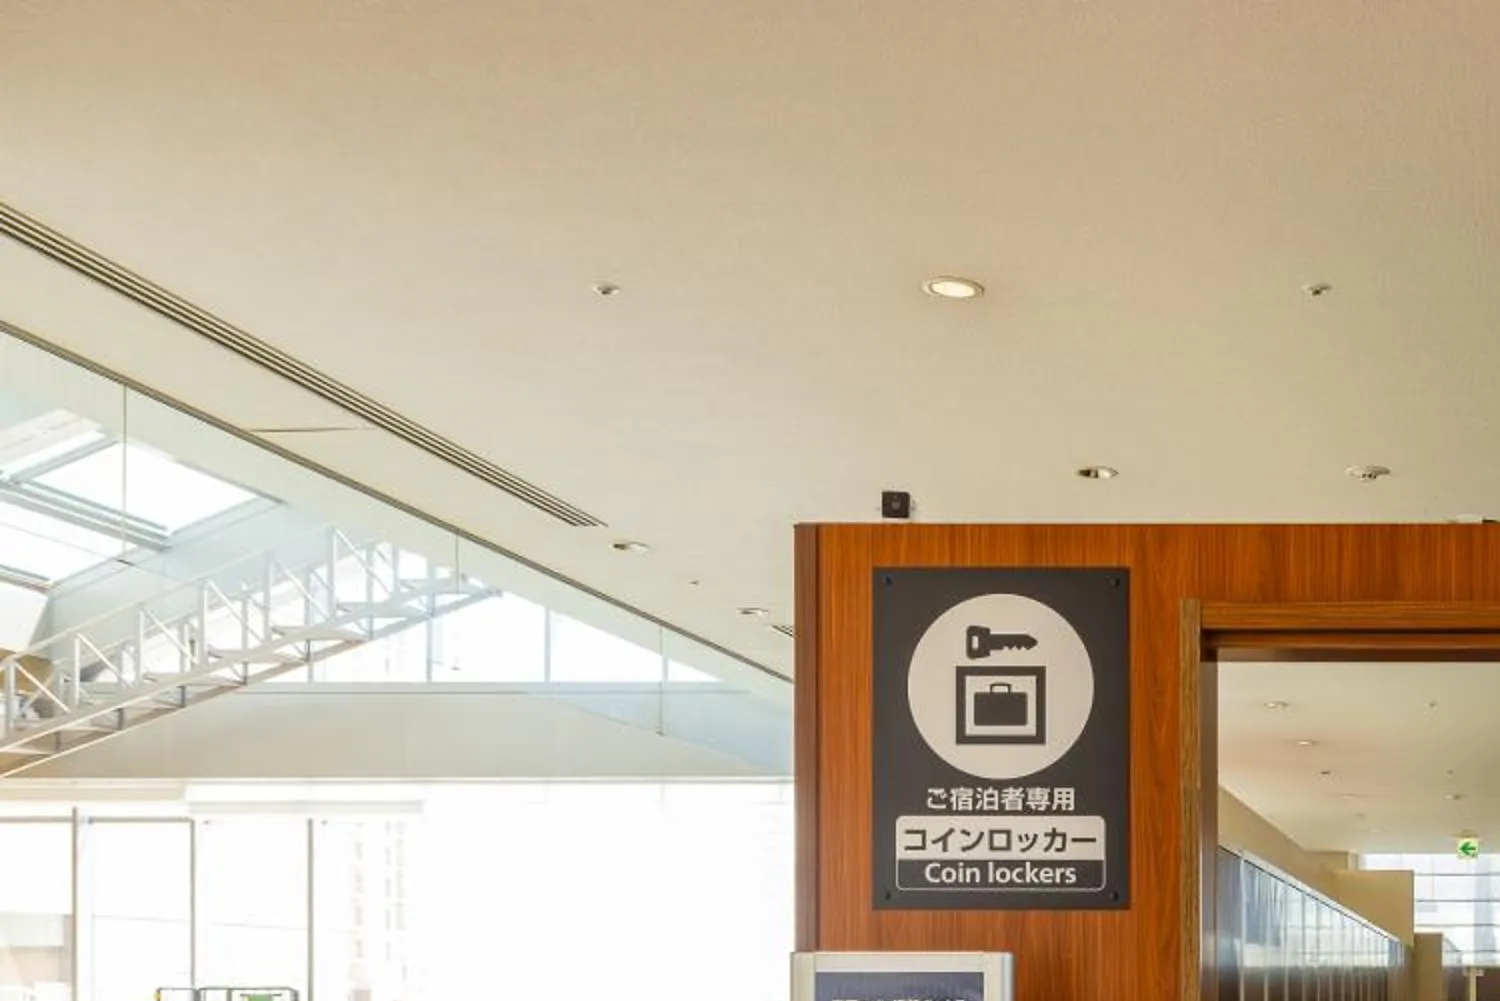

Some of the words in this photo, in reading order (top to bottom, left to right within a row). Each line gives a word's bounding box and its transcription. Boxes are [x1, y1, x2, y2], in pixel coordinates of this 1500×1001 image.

[926, 787, 1076, 812] ご宿泊者専用
[903, 827, 1097, 853] コインロッカー
[924, 861, 982, 884] Coin
[988, 861, 1077, 884] lockers
